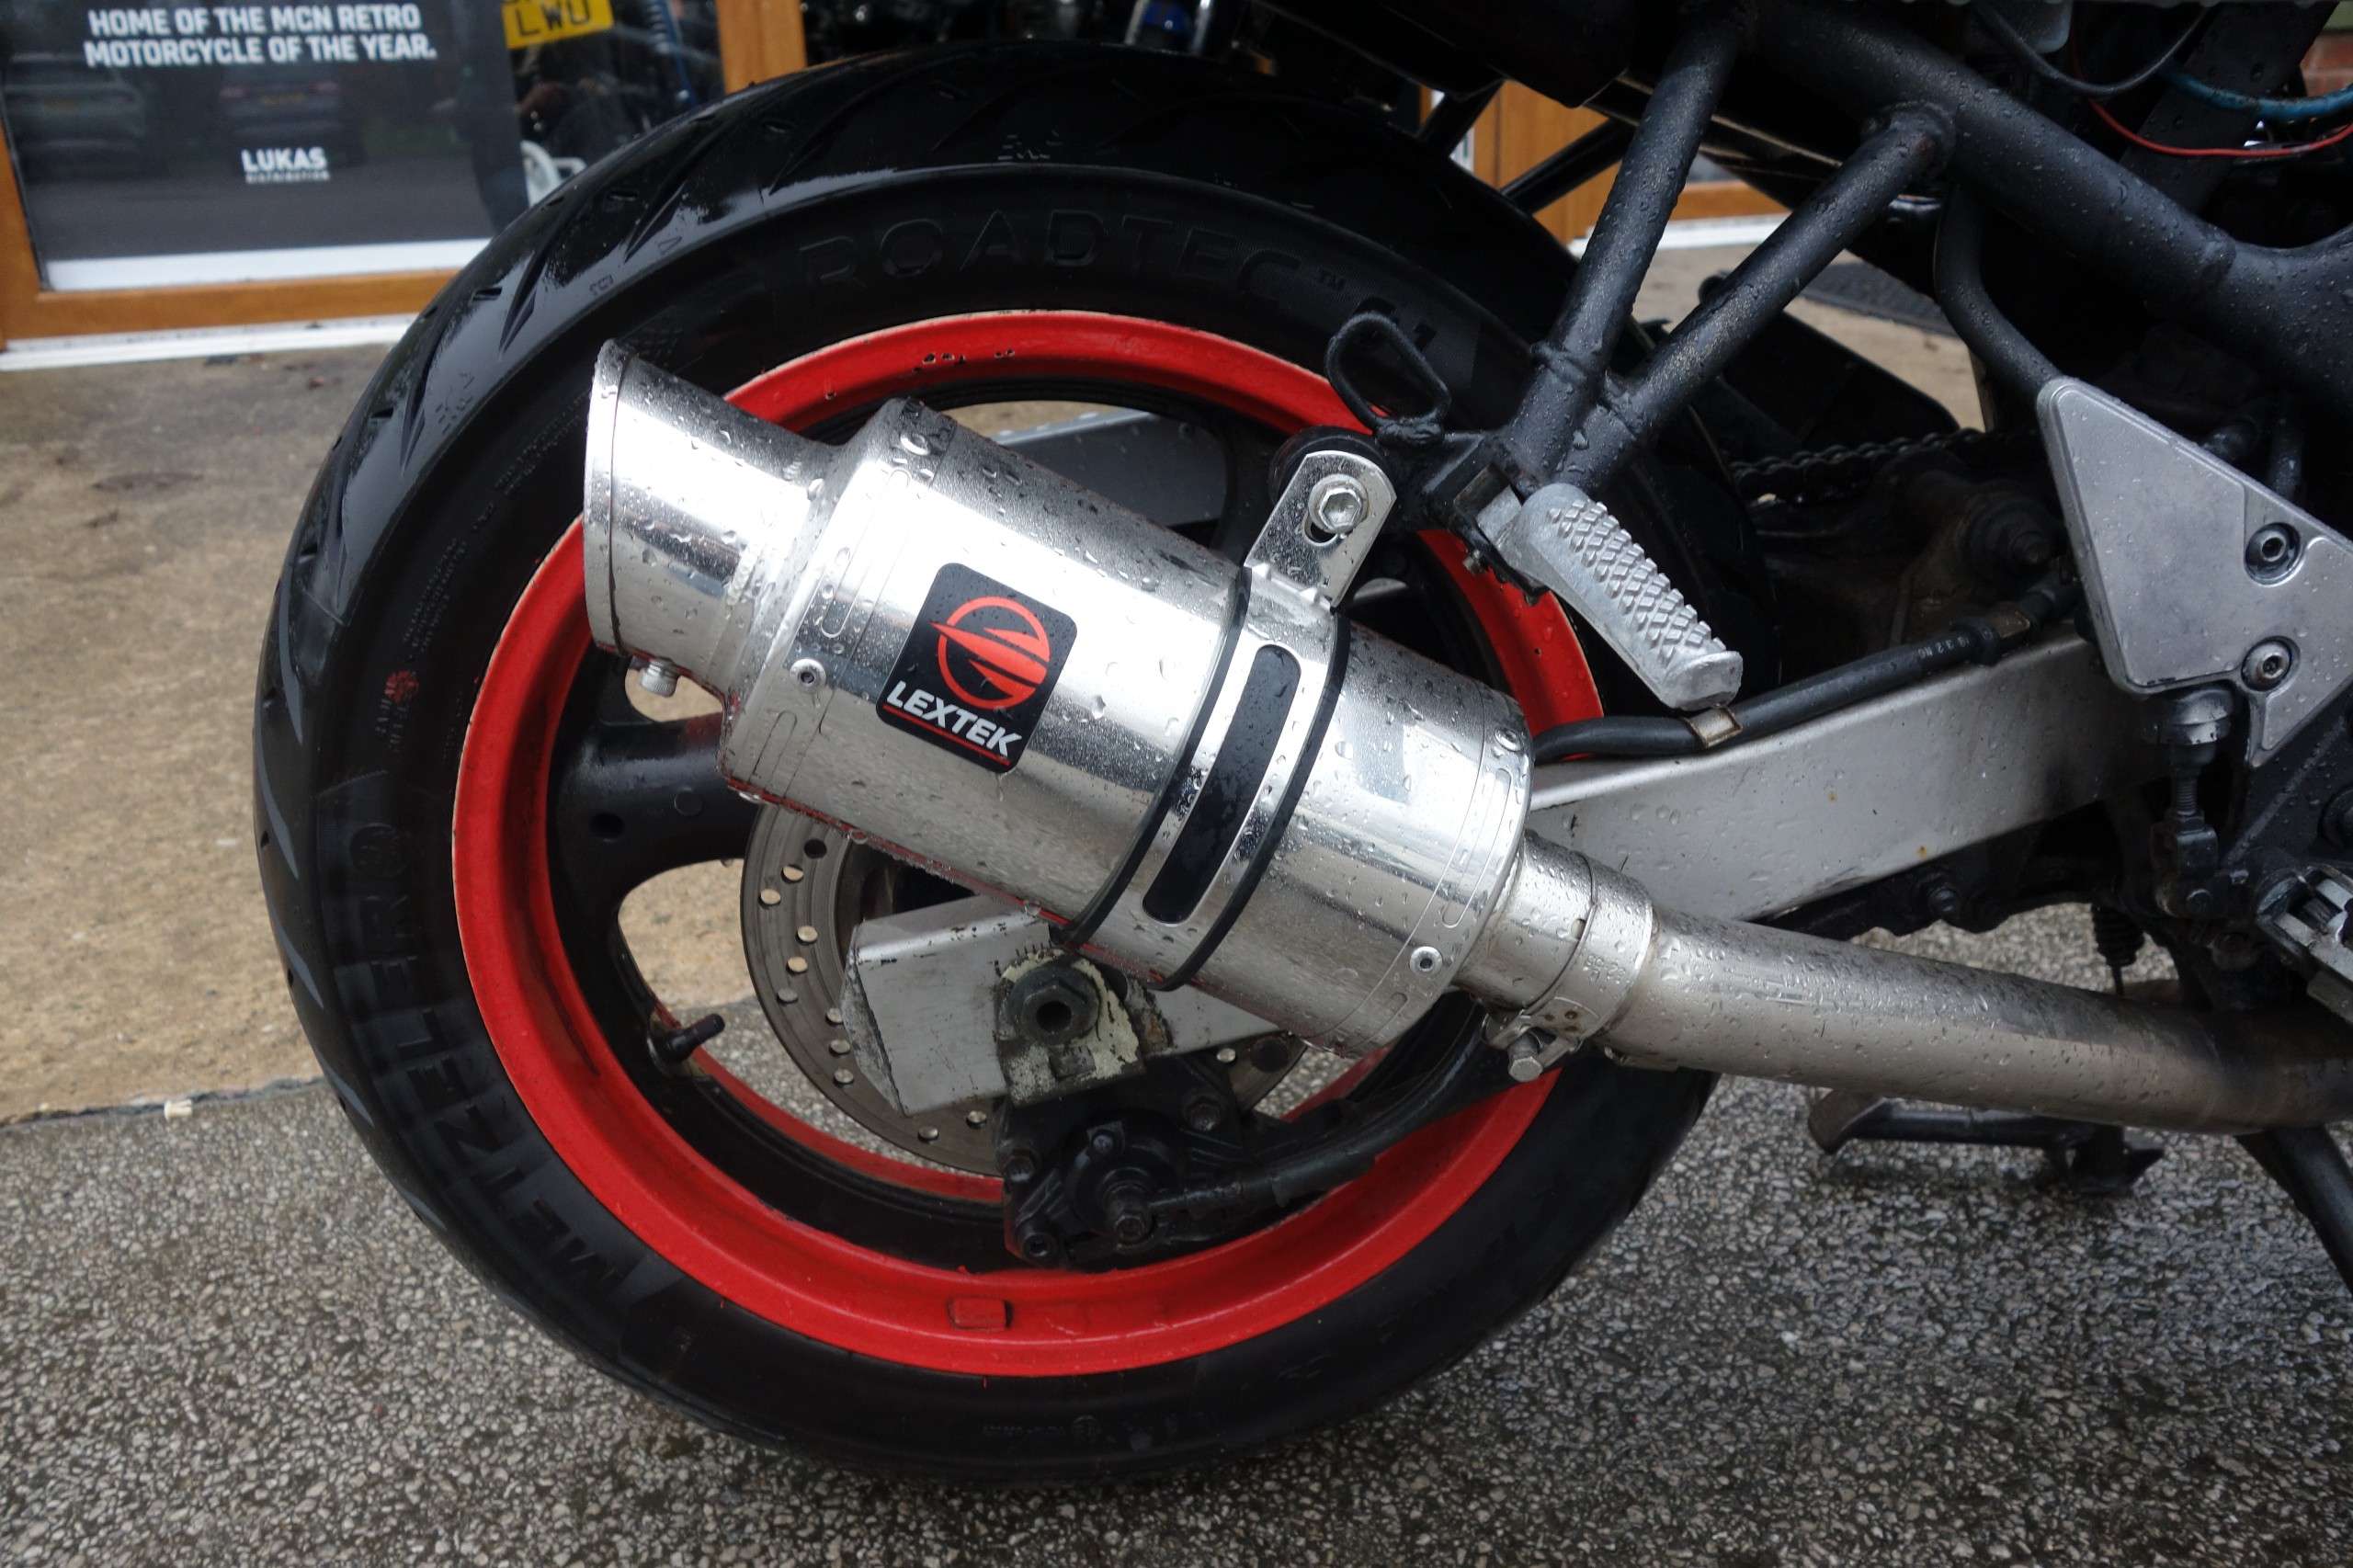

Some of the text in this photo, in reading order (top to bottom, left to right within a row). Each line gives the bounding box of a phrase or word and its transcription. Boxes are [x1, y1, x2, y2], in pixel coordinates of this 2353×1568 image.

[88, 3, 422, 37] HOME OF THE MCN RETRO
[84, 32, 438, 68] MOTORCYCLE OF THE YEAR.
[240, 147, 327, 173] LUKAS
[885, 680, 1023, 757] LEXTEK
